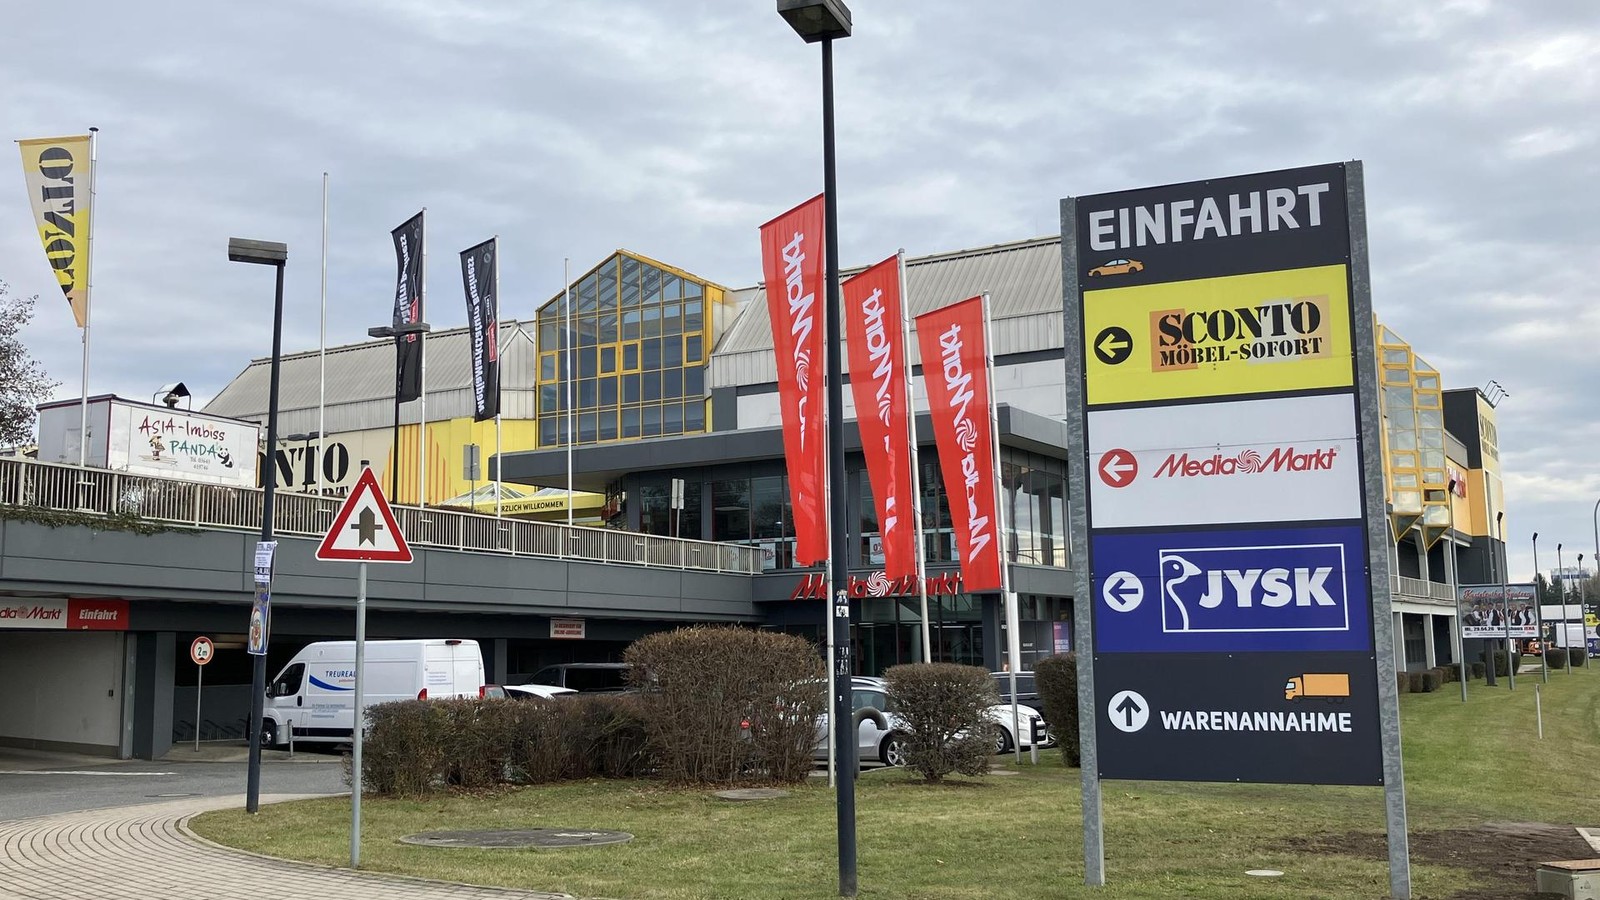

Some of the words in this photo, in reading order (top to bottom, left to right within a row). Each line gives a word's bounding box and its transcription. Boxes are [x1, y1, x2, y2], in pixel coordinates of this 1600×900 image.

[1089, 182, 1330, 252] EINFAHRT
[1158, 301, 1321, 347] SCONTO
[1159, 337, 1323, 367] MÖBEL-SOFORT
[169, 440, 219, 460] PANDA
[257, 442, 349, 488] NTO
[1153, 453, 1237, 479] Media
[1257, 448, 1337, 473] Markt
[494, 504, 522, 513] HRZLICH
[523, 501, 564, 510] WILLKOMMEN
[1199, 567, 1337, 609] JYSK
[26, 606, 62, 620] Markt
[79, 608, 118, 621] Einfahrt
[198, 646, 203, 657] 2
[1160, 711, 1352, 733] WARENANNAHME
